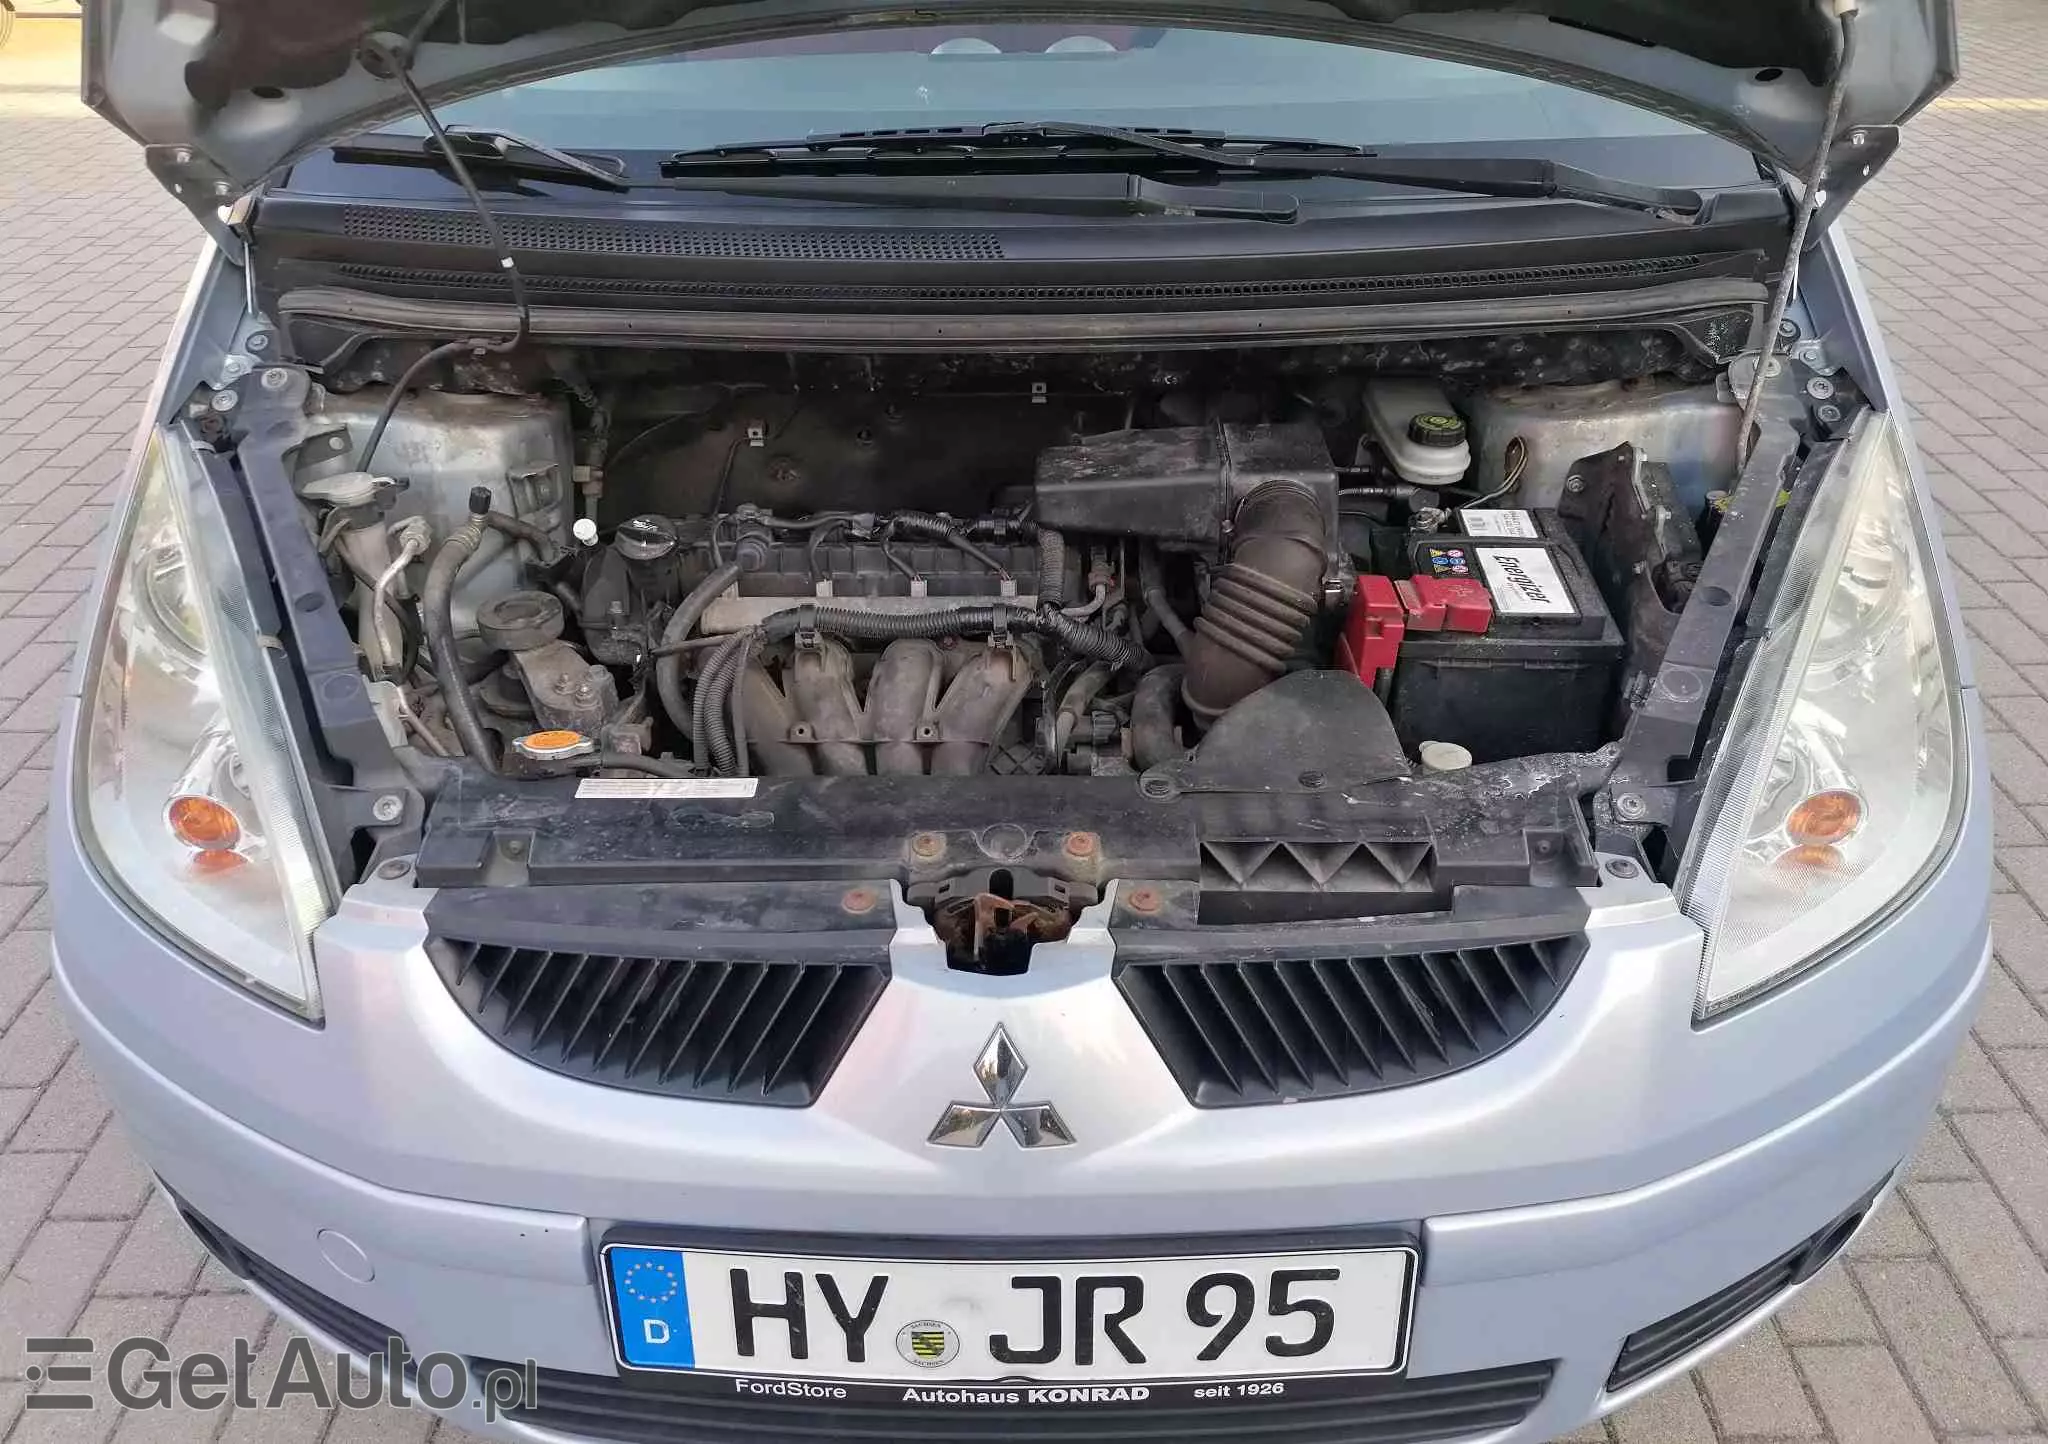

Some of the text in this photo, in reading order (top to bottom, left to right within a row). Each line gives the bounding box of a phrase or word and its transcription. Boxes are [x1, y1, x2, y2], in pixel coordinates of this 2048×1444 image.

[1492, 555, 1550, 604] Energizer
[643, 1318, 671, 1345] D
[730, 1268, 1341, 1366] HY JR 95
[735, 1378, 1285, 1404] FordStore Autohaus KONRAD seit 1926
